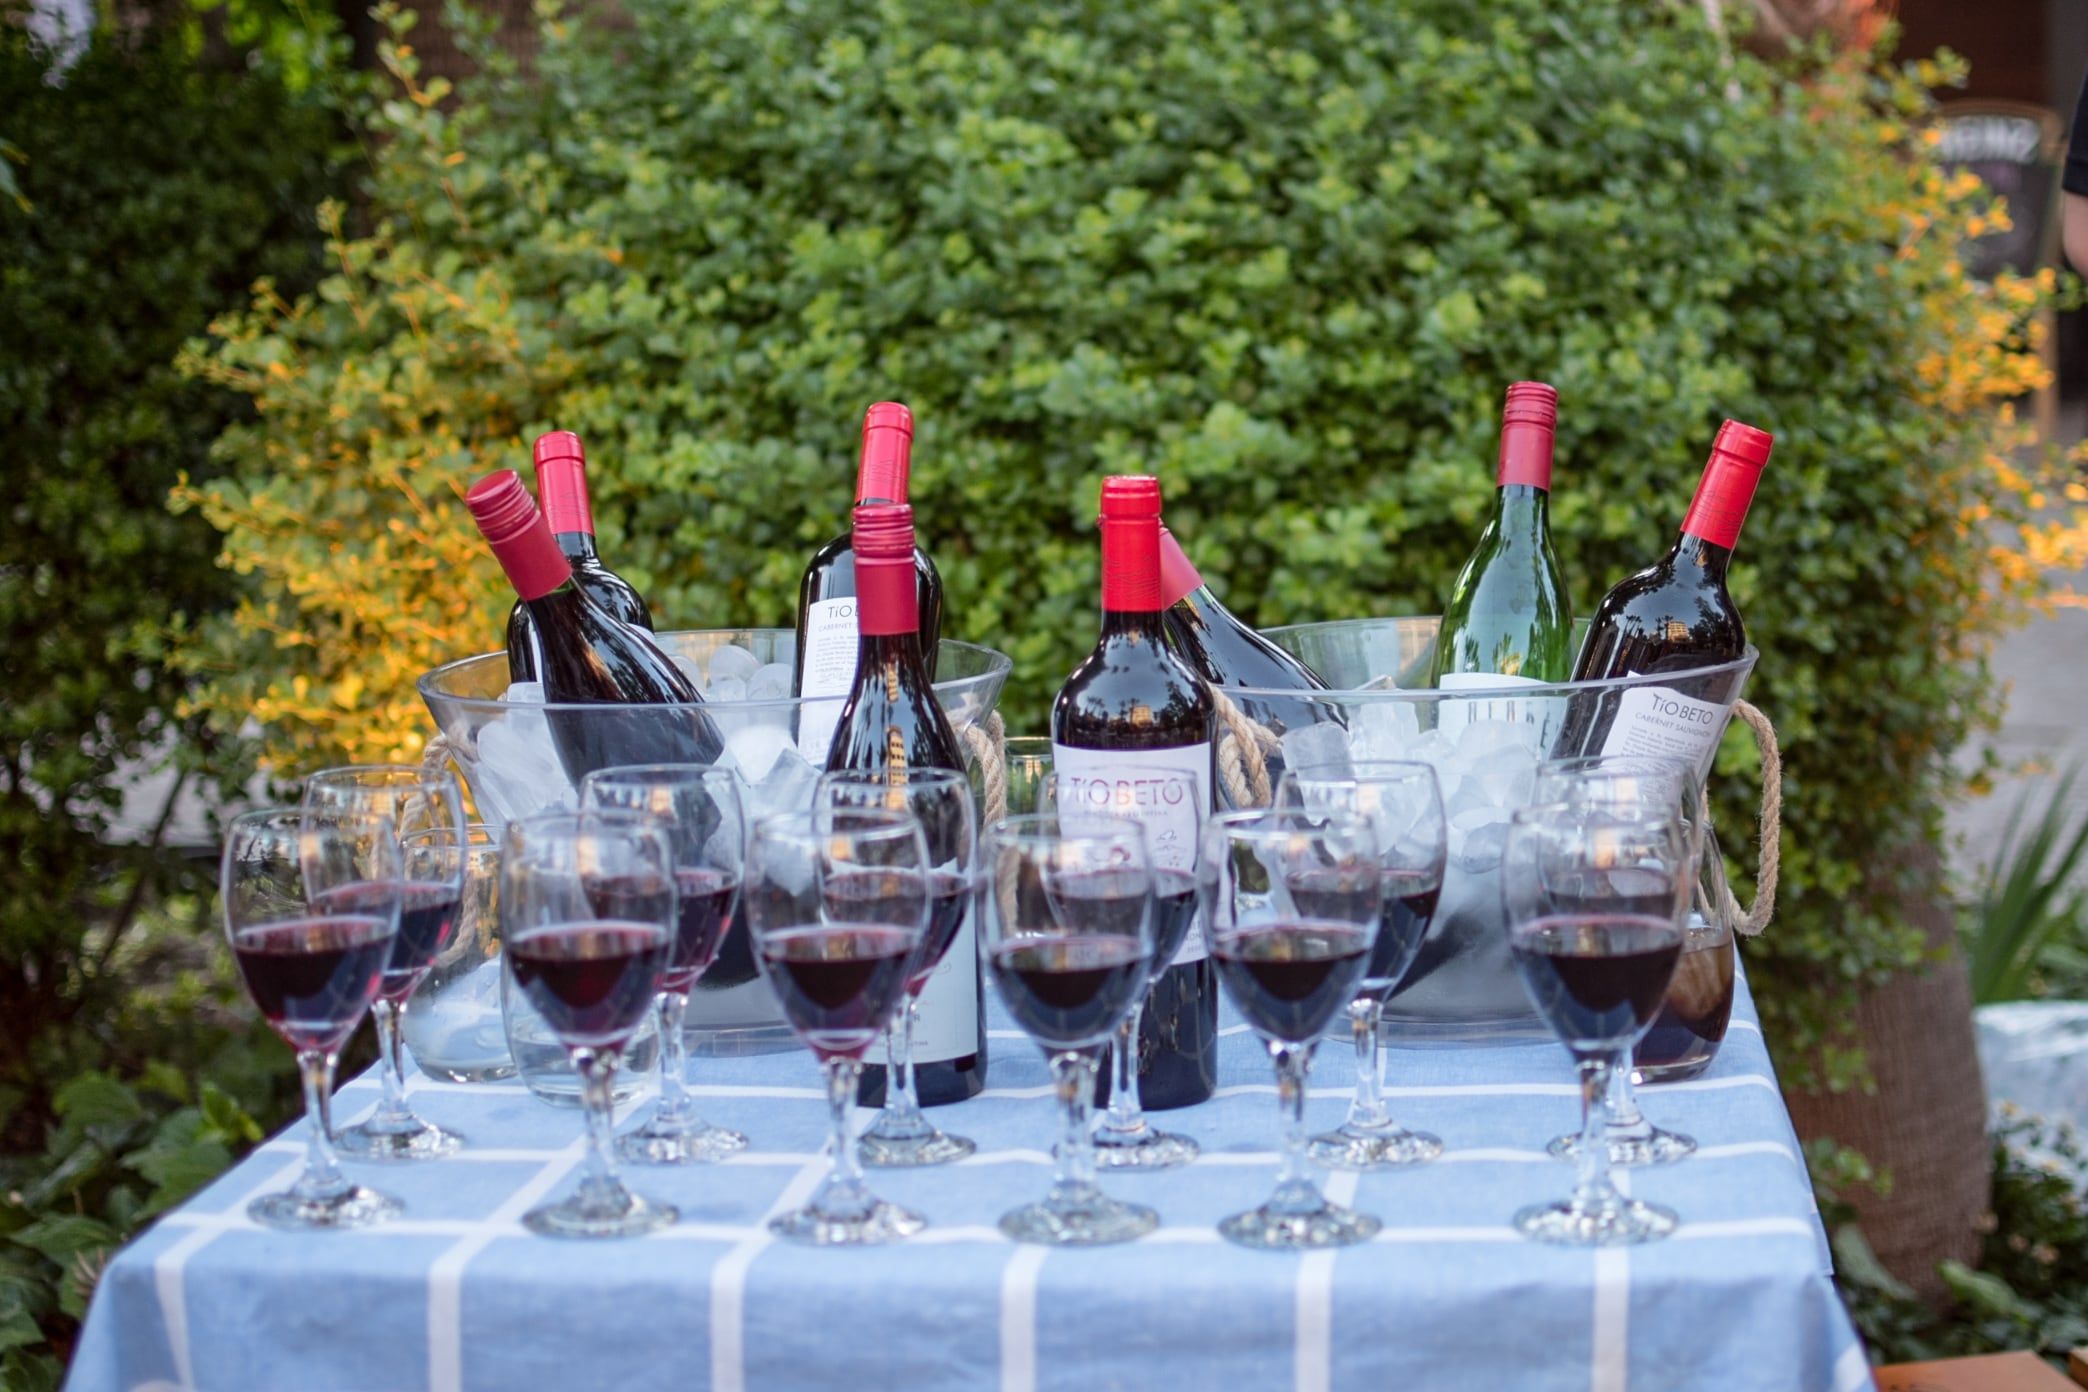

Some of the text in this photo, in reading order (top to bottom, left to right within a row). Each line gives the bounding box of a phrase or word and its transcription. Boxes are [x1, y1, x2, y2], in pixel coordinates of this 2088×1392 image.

[818, 622, 853, 633] CABERNET
[1635, 713, 1710, 737] CABERNET SAUVIGNON
[1679, 705, 1714, 725] BETO
[1116, 777, 1183, 805] BETO
